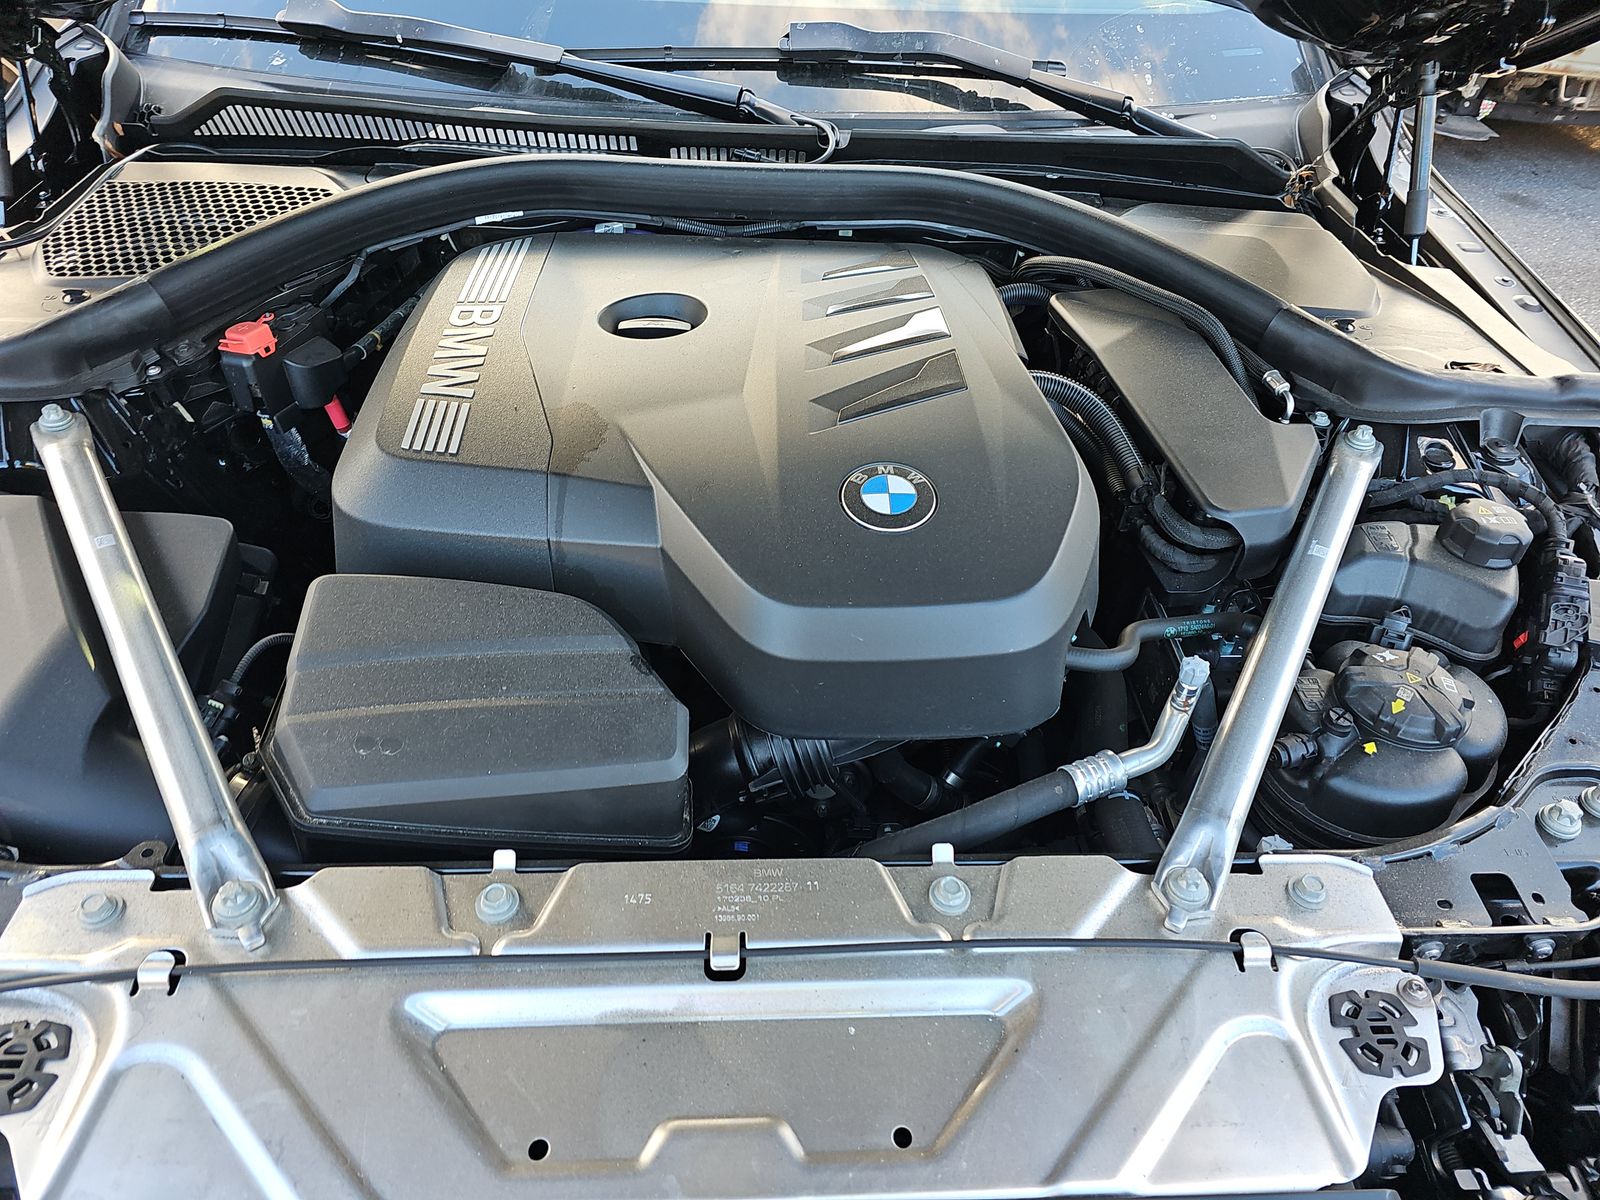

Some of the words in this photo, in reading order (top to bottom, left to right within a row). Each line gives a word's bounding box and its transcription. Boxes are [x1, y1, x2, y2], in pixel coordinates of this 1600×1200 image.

[420, 304, 505, 398] BMW
[849, 464, 926, 485] BMW
[753, 868, 784, 878] BMW
[715, 882, 745, 894] 5164
[749, 881, 799, 893] 7422287
[806, 880, 820, 892] 11
[624, 893, 652, 905] 1475
